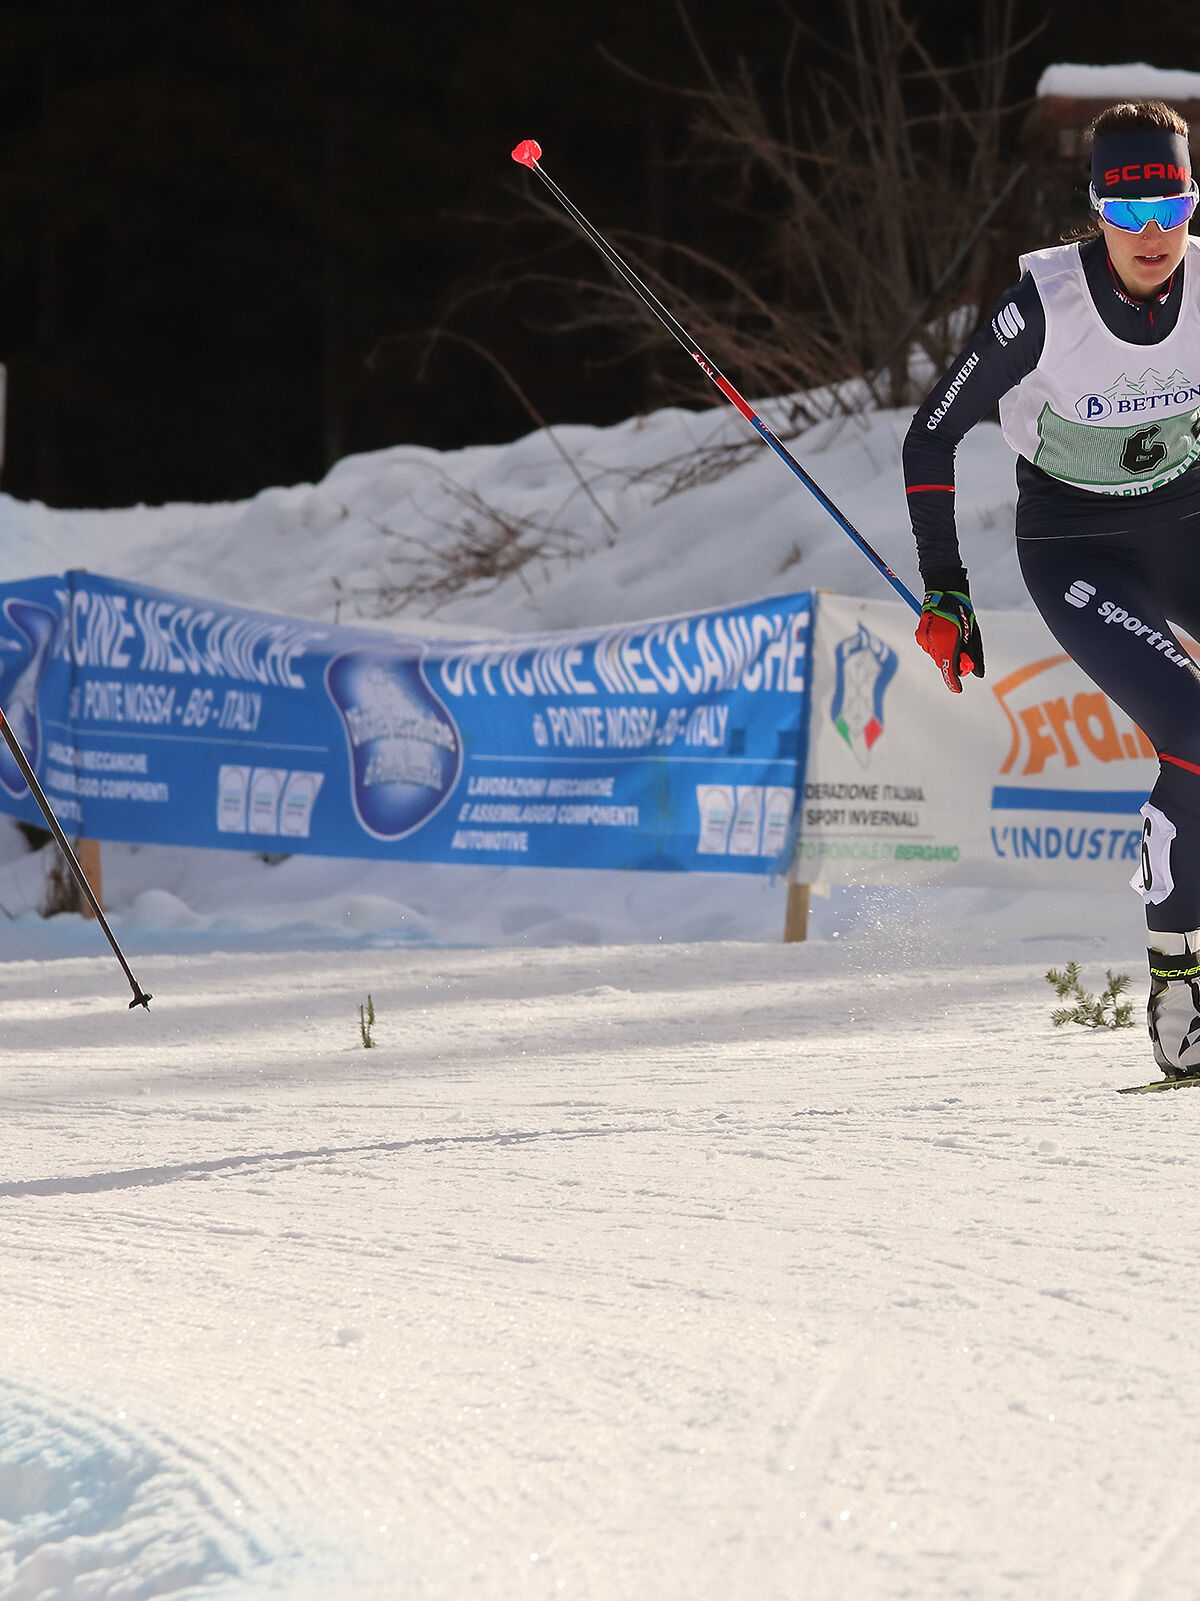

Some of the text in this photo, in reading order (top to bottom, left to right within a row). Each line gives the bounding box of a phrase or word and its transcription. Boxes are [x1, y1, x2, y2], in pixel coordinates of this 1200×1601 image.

[926, 351, 980, 431] CARABINIERI
[1119, 423, 1168, 475] 6
[134, 599, 330, 688] MECCANICHE
[440, 611, 811, 697] OFFICINE MECCANICHE
[1097, 600, 1192, 669] sportful
[546, 706, 605, 748] PONTE
[807, 809, 919, 827] SPORT INVERNALI
[991, 826, 1141, 860] L'INDUSTR
